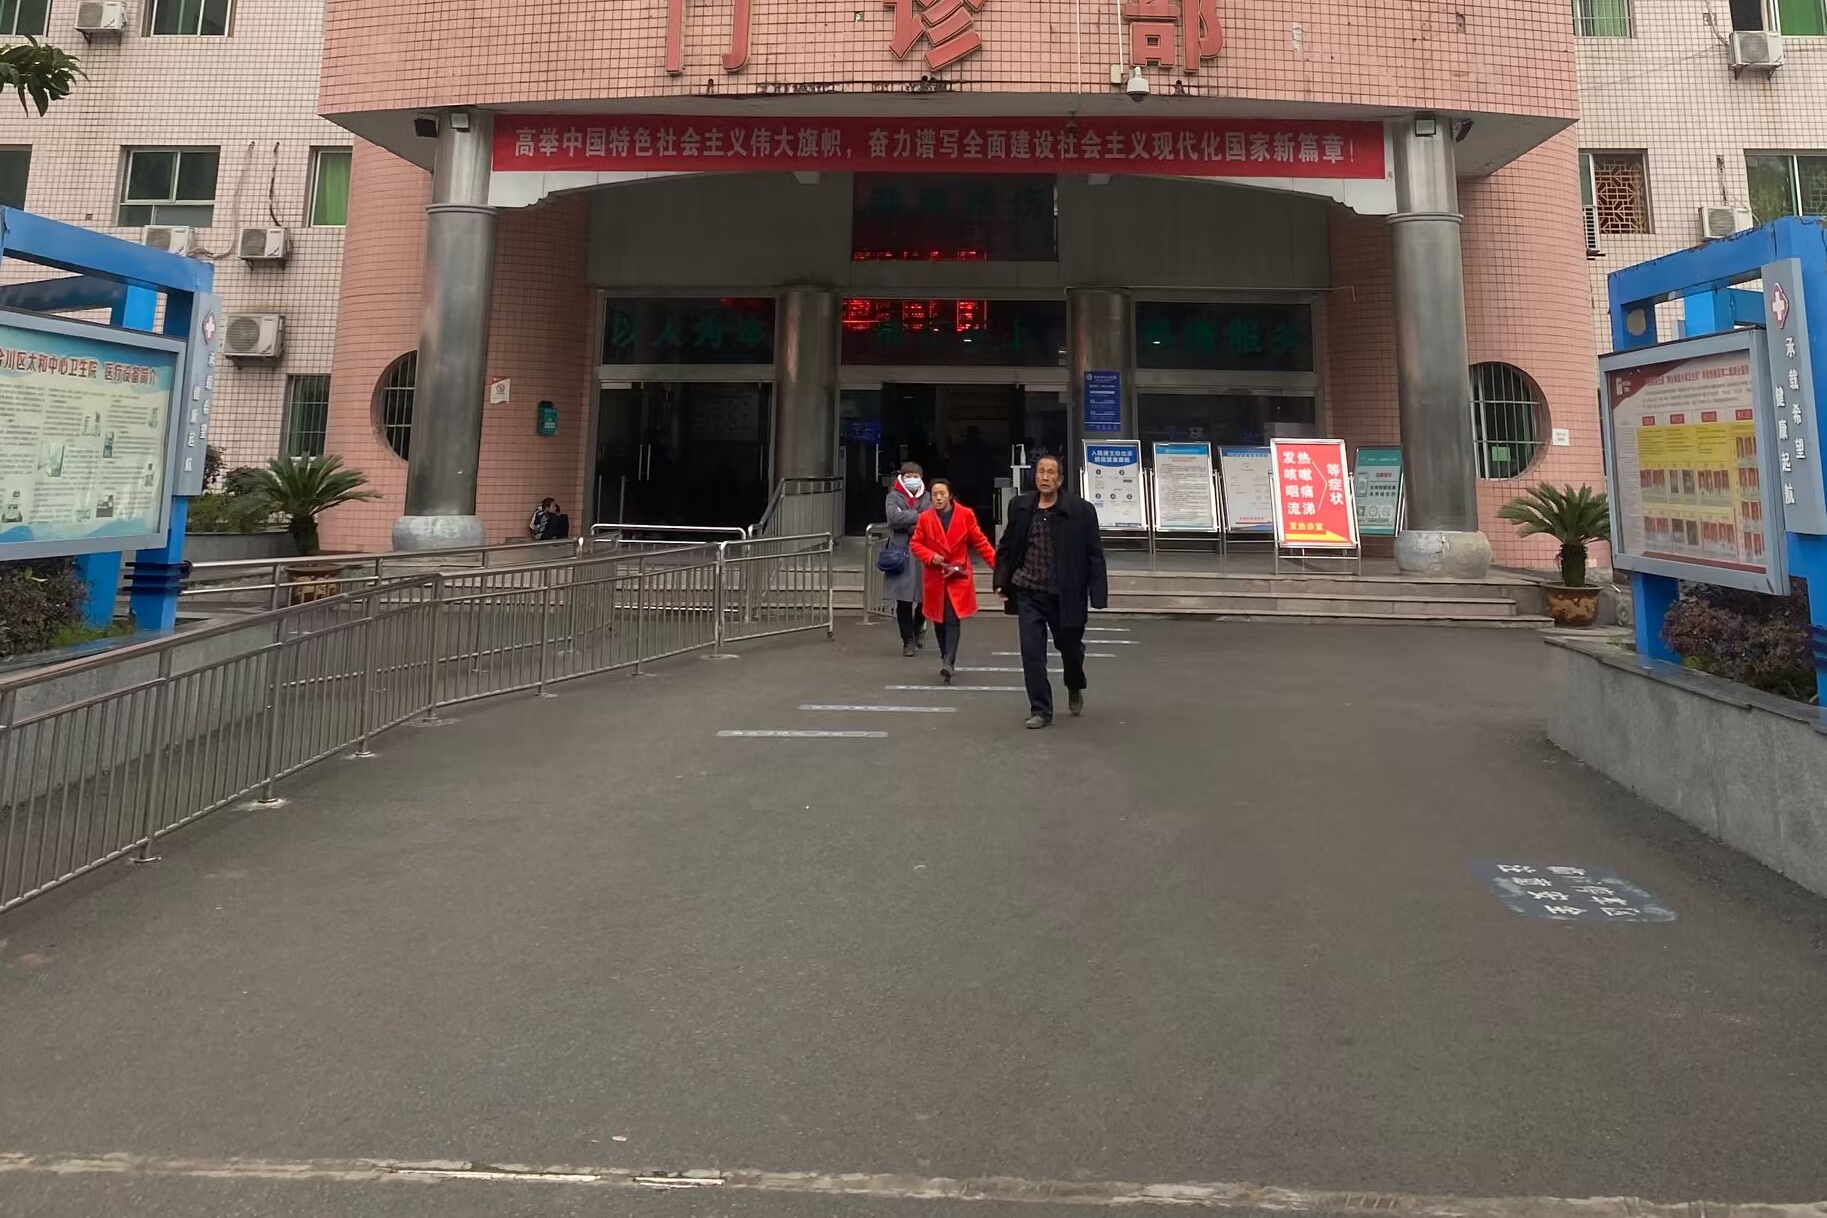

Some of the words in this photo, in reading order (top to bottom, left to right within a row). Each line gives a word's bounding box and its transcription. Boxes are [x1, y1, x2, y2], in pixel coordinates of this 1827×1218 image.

[1785, 337, 1806, 459] 承载希望
[1775, 386, 1796, 505] 健康起航
[1283, 451, 1311, 464] 发热
[1284, 468, 1312, 481] 咳嗽
[1326, 463, 1344, 505] 等症状
[1285, 485, 1314, 498] 咽痛
[1287, 502, 1316, 515] 流涕
